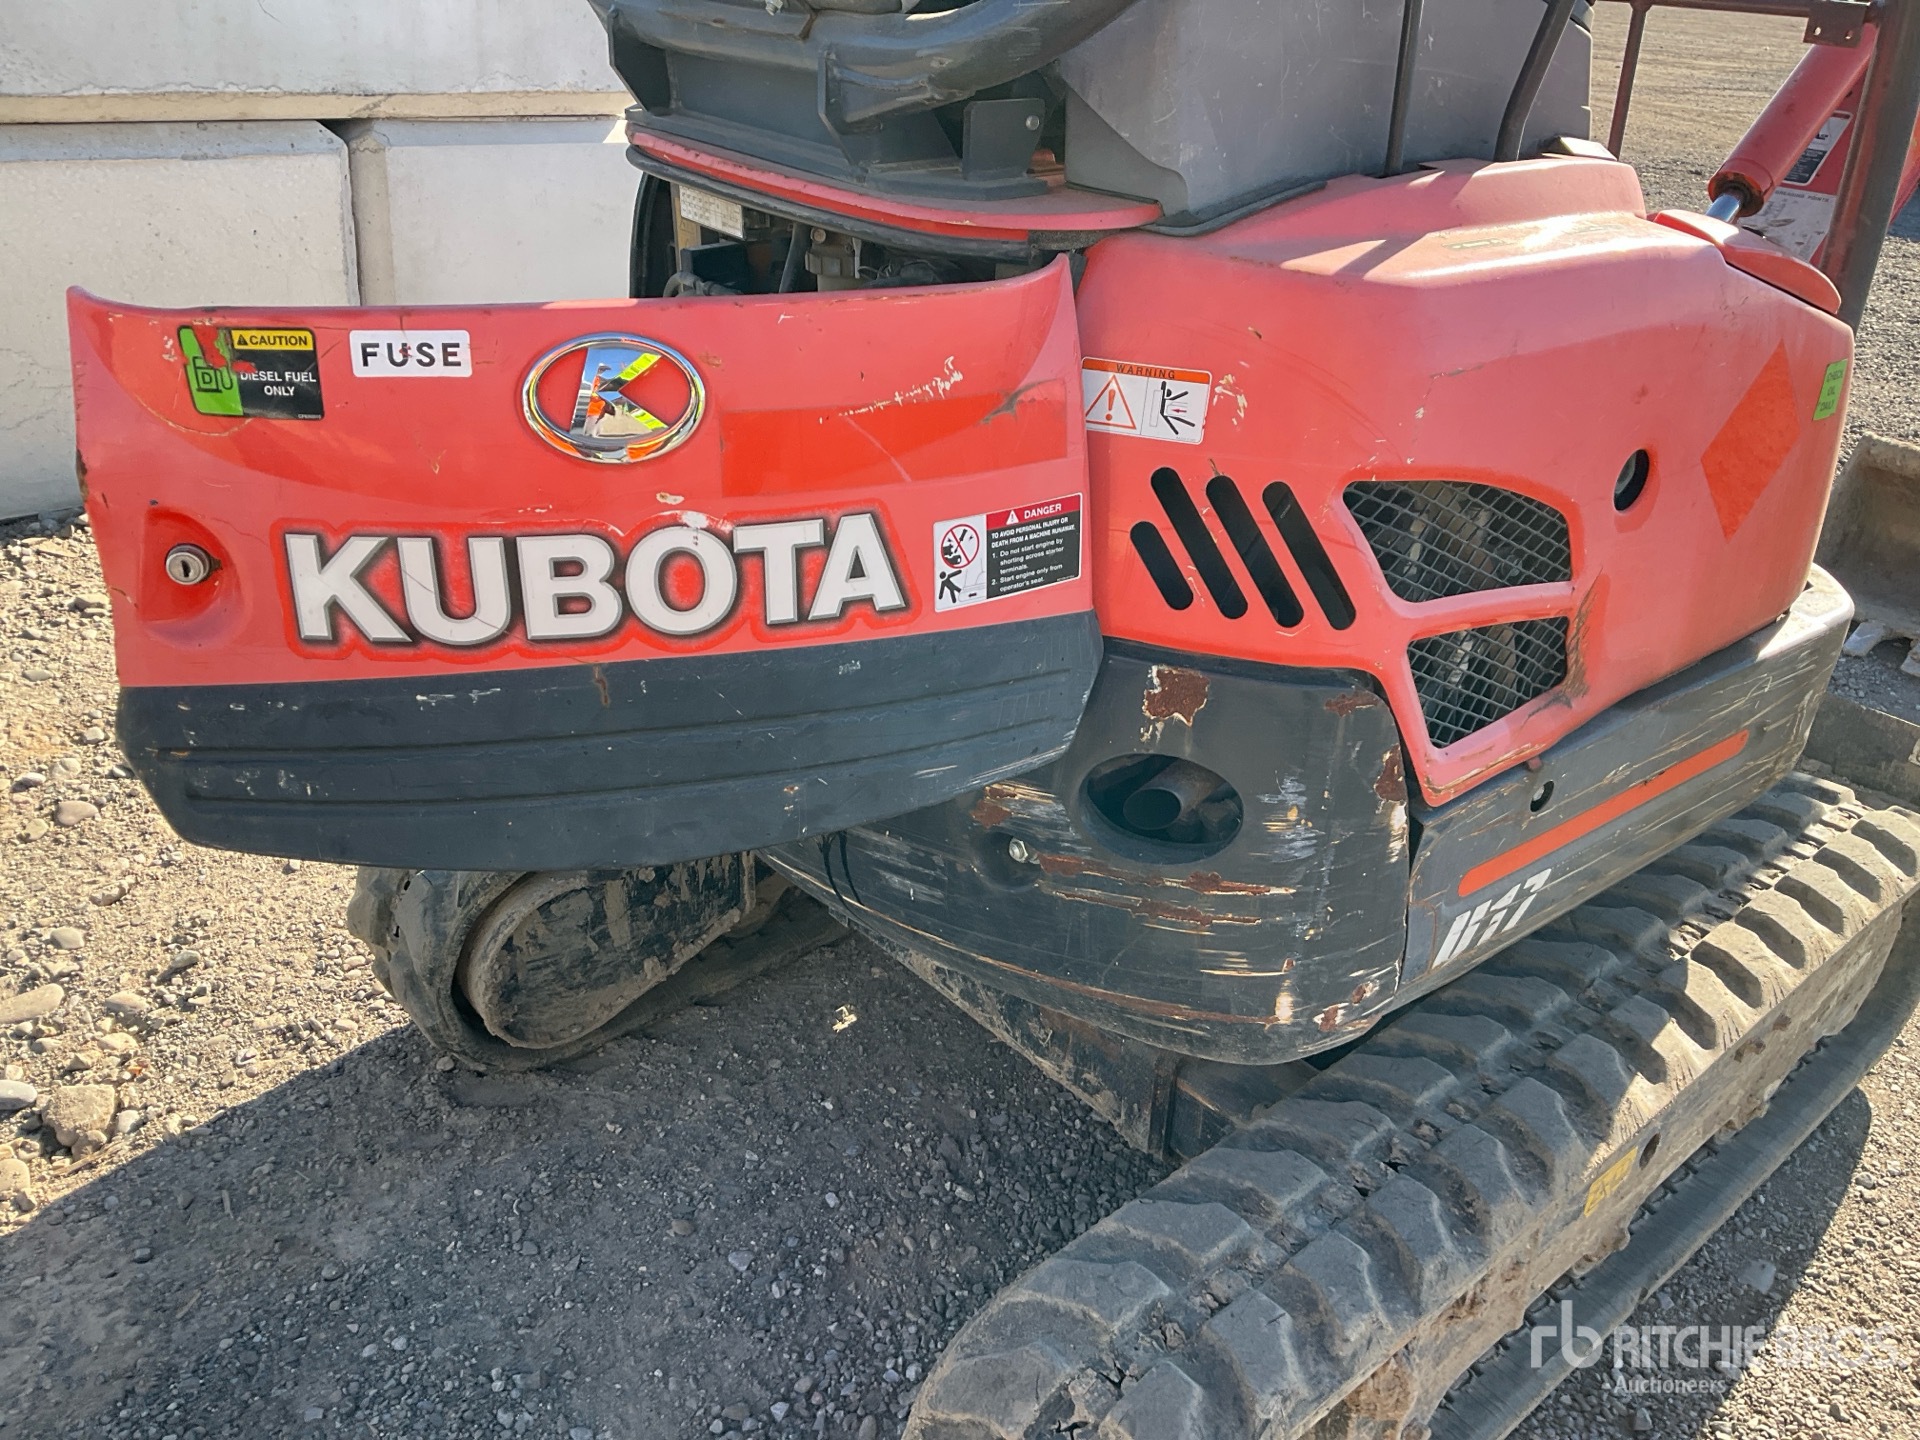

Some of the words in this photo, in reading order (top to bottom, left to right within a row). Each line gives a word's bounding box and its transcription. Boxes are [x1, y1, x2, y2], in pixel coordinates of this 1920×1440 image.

[249, 335, 308, 346] CAUTION
[360, 342, 462, 368] FUSE
[240, 370, 283, 382] DIESEL
[284, 371, 317, 383] FUEL
[1115, 363, 1176, 380] WARNING
[263, 385, 296, 397] ONLY
[1024, 504, 1062, 520] DANGER
[1000, 529, 1015, 538] AVOID
[1015, 523, 1042, 534] PERSONAL
[1042, 518, 1061, 529] INJURY
[1060, 516, 1069, 524] OR
[991, 539, 1009, 549] DEATH
[1009, 536, 1024, 545] FROM
[1029, 530, 1051, 540] MACHINE
[1010, 547, 1020, 555] not
[1021, 544, 1035, 552] start
[1035, 539, 1055, 549] engine
[1055, 537, 1064, 545] by
[1000, 555, 1024, 566] shorting
[1025, 551, 1045, 560] across
[284, 512, 907, 646] KUBOTA
[1000, 574, 1015, 583] Start
[1015, 570, 1036, 579] engine
[1036, 567, 1049, 575] only
